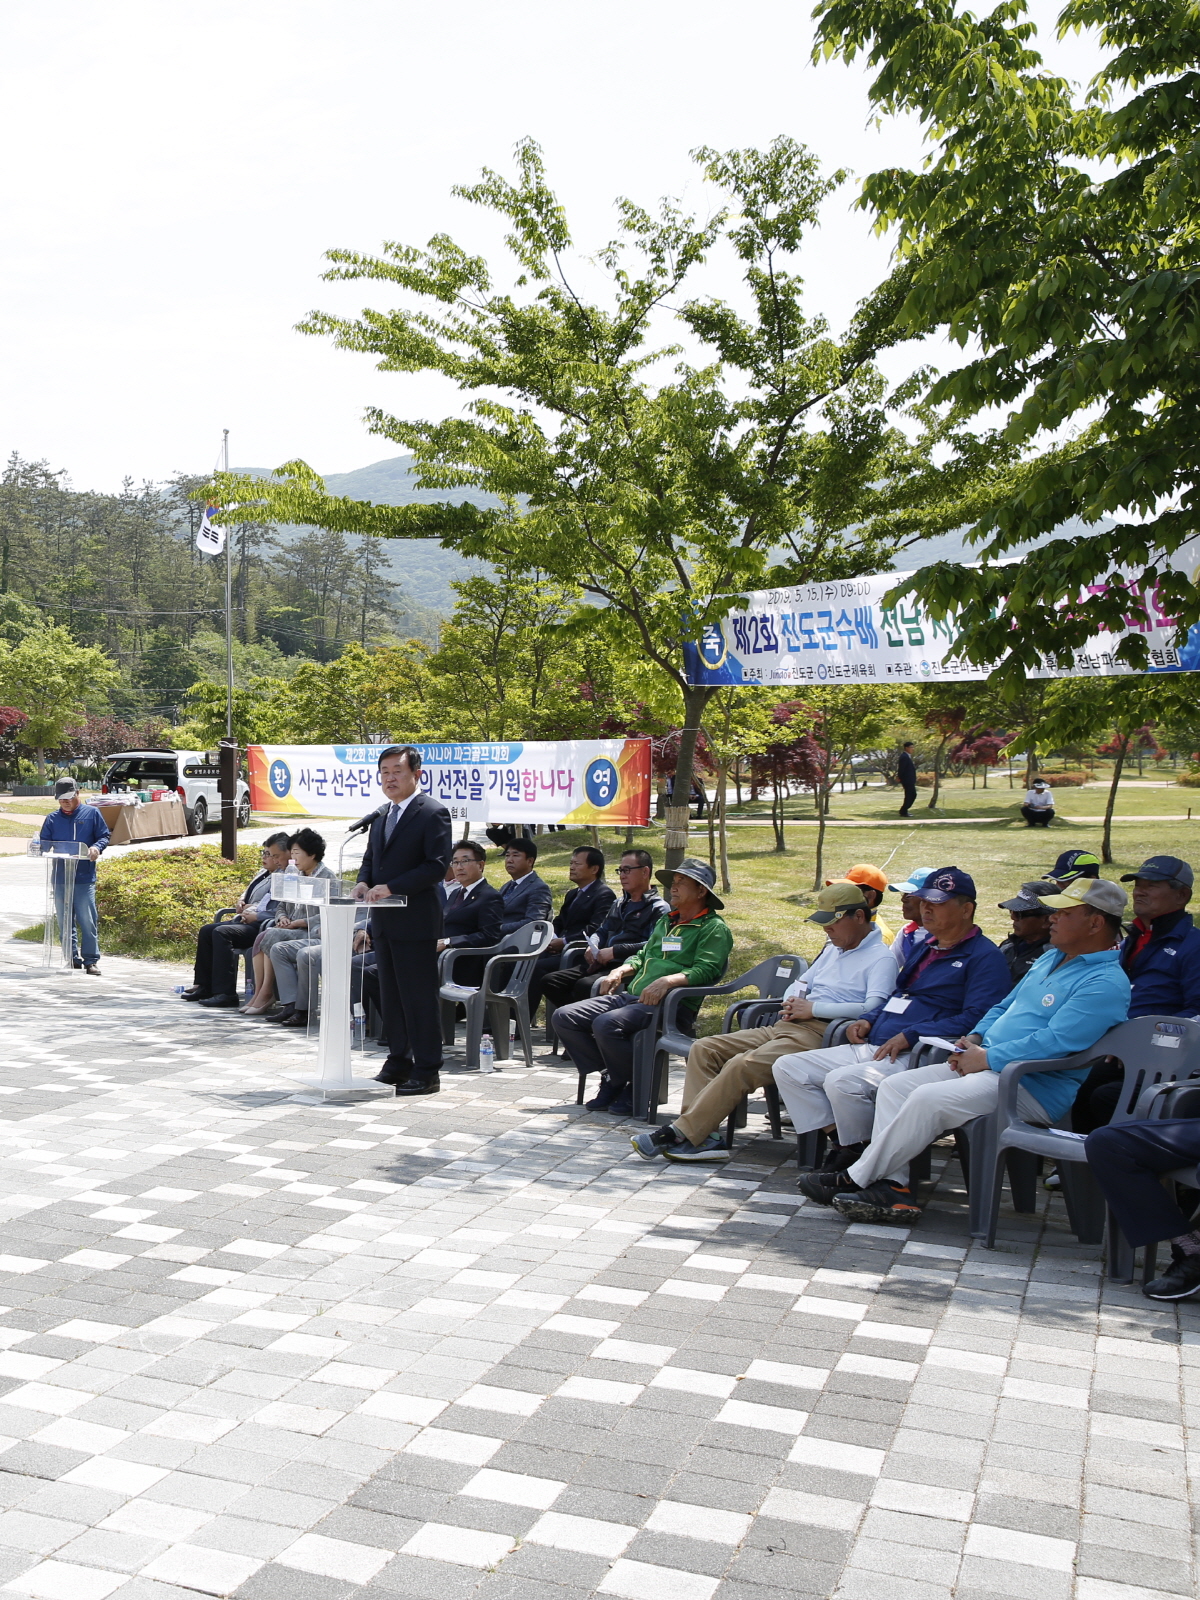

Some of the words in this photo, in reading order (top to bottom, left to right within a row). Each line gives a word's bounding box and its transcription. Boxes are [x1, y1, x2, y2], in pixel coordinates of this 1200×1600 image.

[841, 581, 871, 598] 09:00
[702, 623, 720, 656] 축
[732, 613, 779, 655] 제2회
[781, 605, 880, 653] 진도군수배
[879, 603, 925, 647] 전남
[827, 663, 877, 678] 진도군체육회
[345, 747, 366, 762] 제2회
[427, 746, 451, 763] 시니어
[453, 746, 490, 762] 파크골프
[491, 745, 510, 762] 대회
[273, 766, 287, 792] 환
[331, 769, 373, 797] 선수단
[437, 769, 485, 801] 선전을
[488, 769, 575, 802] 기원합니다
[593, 767, 611, 798] 영
